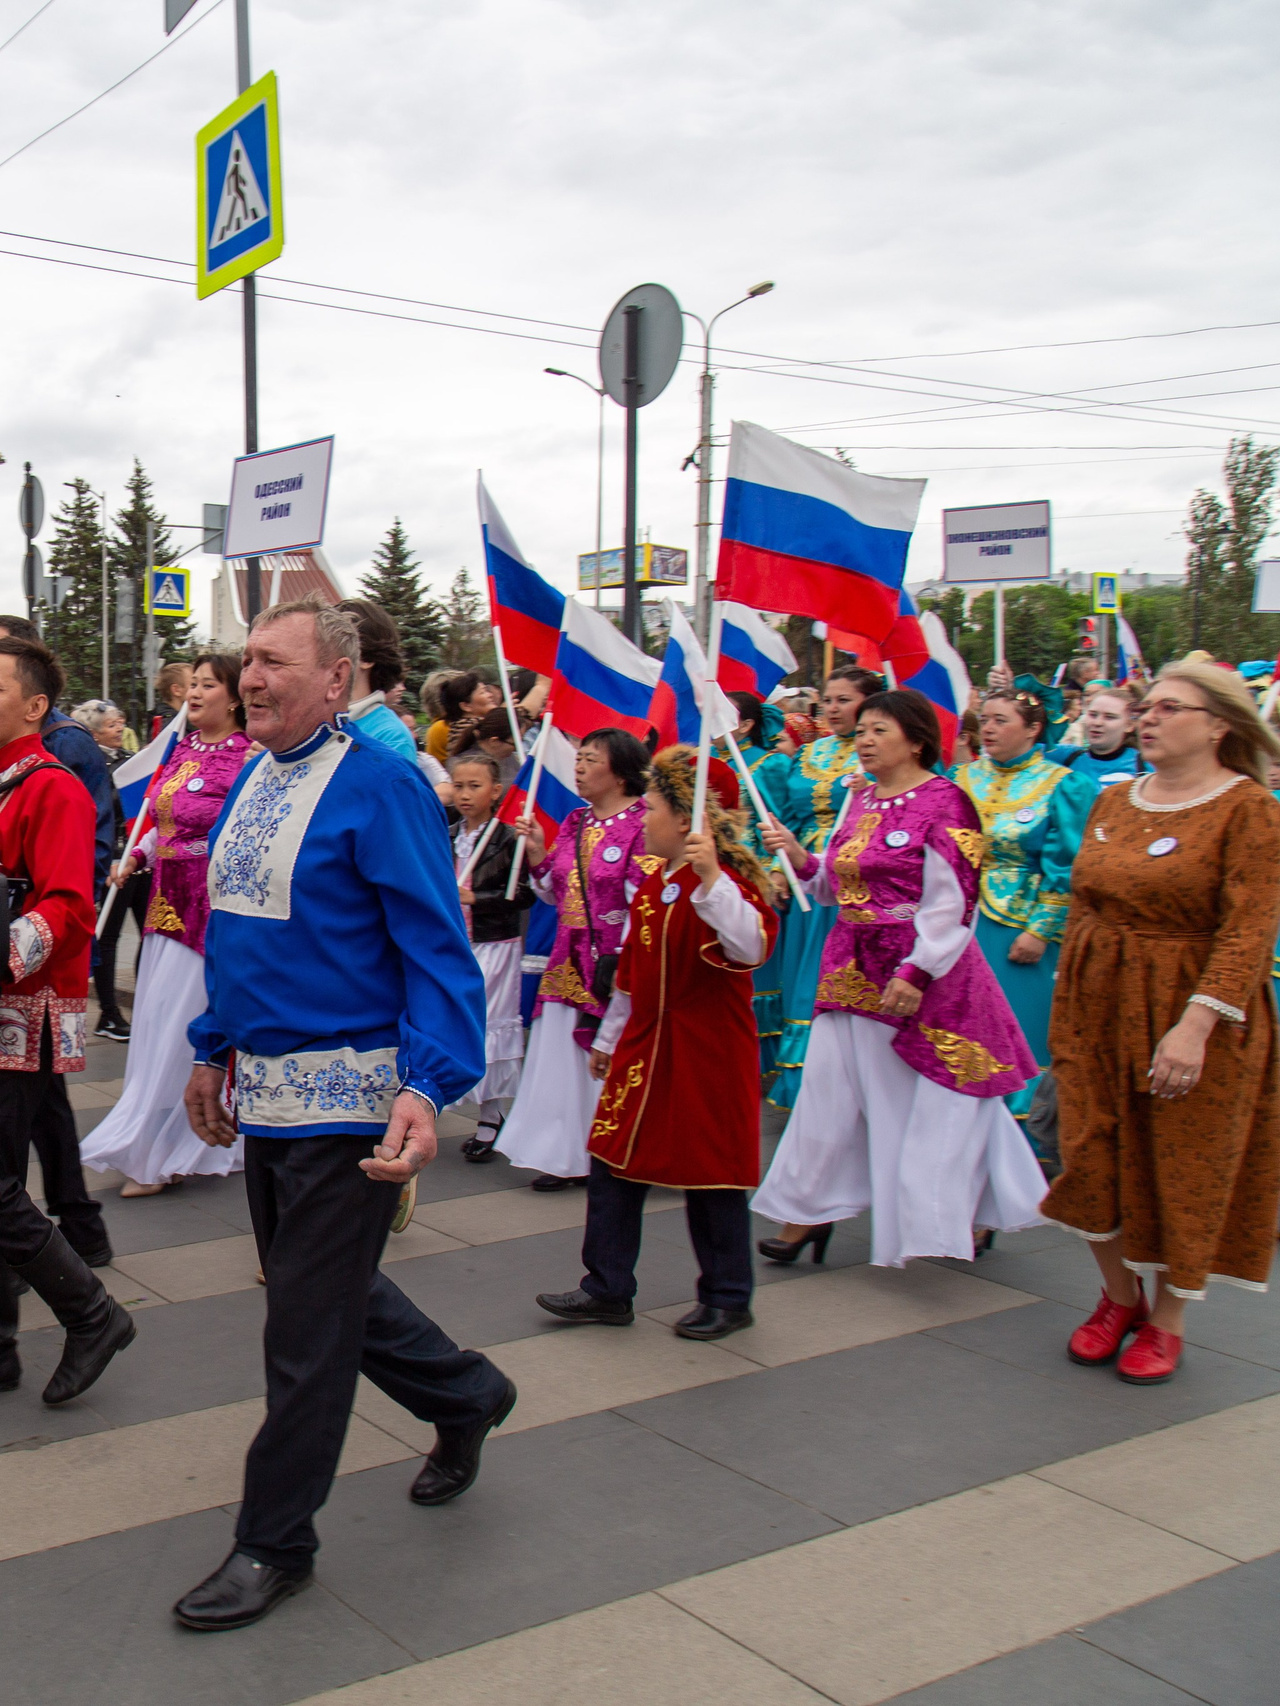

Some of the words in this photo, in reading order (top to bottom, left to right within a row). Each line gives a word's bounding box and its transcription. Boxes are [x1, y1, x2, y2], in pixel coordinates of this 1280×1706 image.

[254, 473, 304, 499] ОДЕССКИЙ
[260, 502, 291, 521] РАЙОН
[979, 544, 1012, 556] РАЙОН
